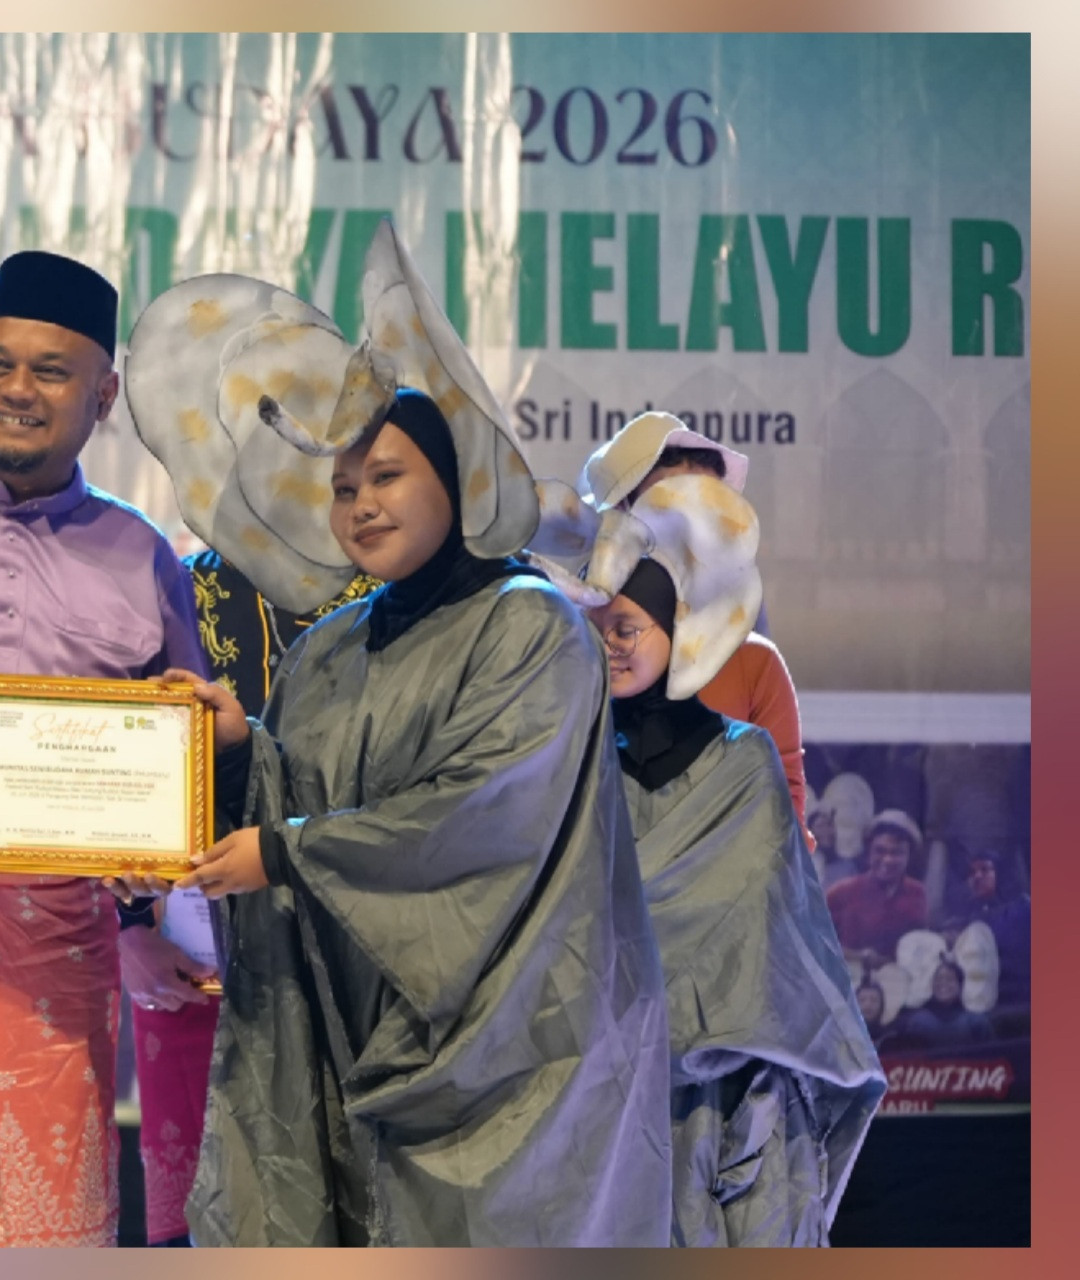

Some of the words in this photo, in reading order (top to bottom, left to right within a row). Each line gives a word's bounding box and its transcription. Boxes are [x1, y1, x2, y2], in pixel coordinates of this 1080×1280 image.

[511, 84, 719, 167] 2026
[444, 210, 912, 358] MELAYU
[518, 399, 572, 443] Sri
[888, 1065, 1008, 1093] SUNTING
